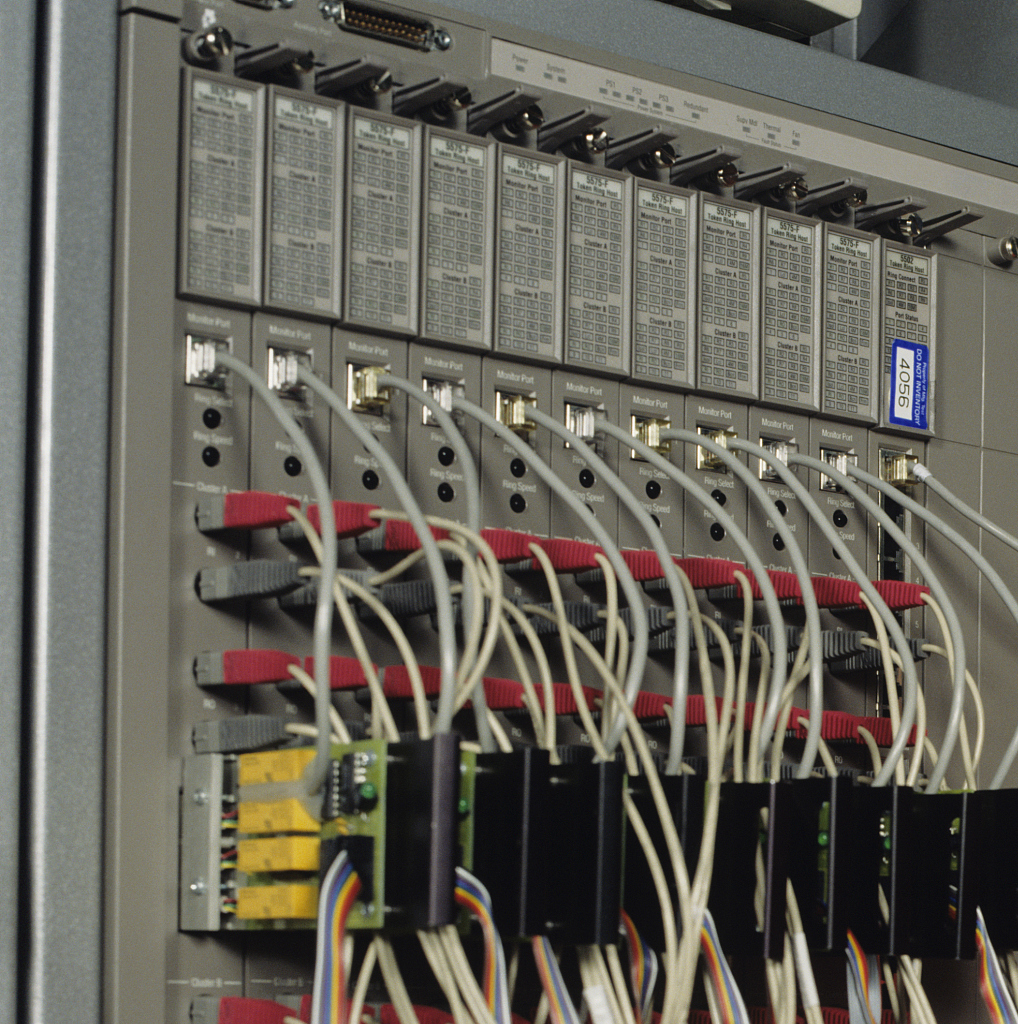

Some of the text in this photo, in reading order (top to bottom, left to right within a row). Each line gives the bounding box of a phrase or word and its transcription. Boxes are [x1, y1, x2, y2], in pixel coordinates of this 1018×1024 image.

[512, 54, 528, 64] Power
[546, 63, 566, 74] System
[606, 79, 616, 89] PS1
[632, 86, 642, 96] PS2
[658, 93, 668, 103] PS3
[683, 101, 708, 113] Redundant
[763, 122, 781, 132] Thermal
[586, 176, 608, 188] 5575-F
[576, 181, 618, 198] Token Ring Host
[574, 194, 606, 208] Monitor Port
[651, 193, 673, 205] 5575-F
[642, 199, 682, 214] Token Ring Host
[640, 211, 671, 224] Monitor Port
[716, 207, 737, 219] 5575-F
[707, 212, 746, 228] Token Ring Host
[706, 225, 735, 237] Monitor Port
[779, 222, 799, 233] 5575-F
[770, 227, 784, 236] Token
[786, 231, 796, 240] Ring
[583, 238, 602, 248] Cluster
[769, 239, 786, 249] Monitor
[839, 237, 859, 249] 5575-F
[831, 243, 844, 252] Token
[845, 247, 856, 255] Ring
[649, 255, 667, 264] Cluster
[830, 254, 846, 264] Monitor
[900, 254, 913, 264] 5502
[714, 267, 731, 277] Cluster
[889, 259, 924, 274] Token Ring Host
[887, 270, 915, 284] Ring Connect
[777, 281, 794, 291] Cluster
[583, 301, 600, 311] Cluster
[838, 296, 853, 305] Cluster
[649, 317, 666, 326] Cluster
[895, 311, 918, 322] Port Status
[714, 328, 730, 337] Cluster
[777, 341, 792, 350] Cluster
[837, 354, 852, 363] Cluster
[916, 348, 922, 361] DO
[424, 357, 464, 371] Monitor Port
[497, 370, 534, 384] Monitor Port
[898, 358, 910, 408] 4056
[566, 382, 602, 396] Monitor Port
[633, 395, 668, 409] Monitor Port
[698, 406, 732, 419] Monitor Port
[762, 418, 794, 431] Monitor Port
[822, 429, 853, 442] Monitor Port
[572, 455, 587, 466] Ring
[639, 467, 653, 478] Ring
[503, 480, 537, 493] Ring Speed
[705, 477, 734, 488] Ring Select
[586, 493, 604, 503] Speed
[768, 487, 796, 500] Ring Select
[653, 503, 670, 513] Speed
[827, 497, 855, 509] Ring Select
[840, 532, 855, 541] Speed
